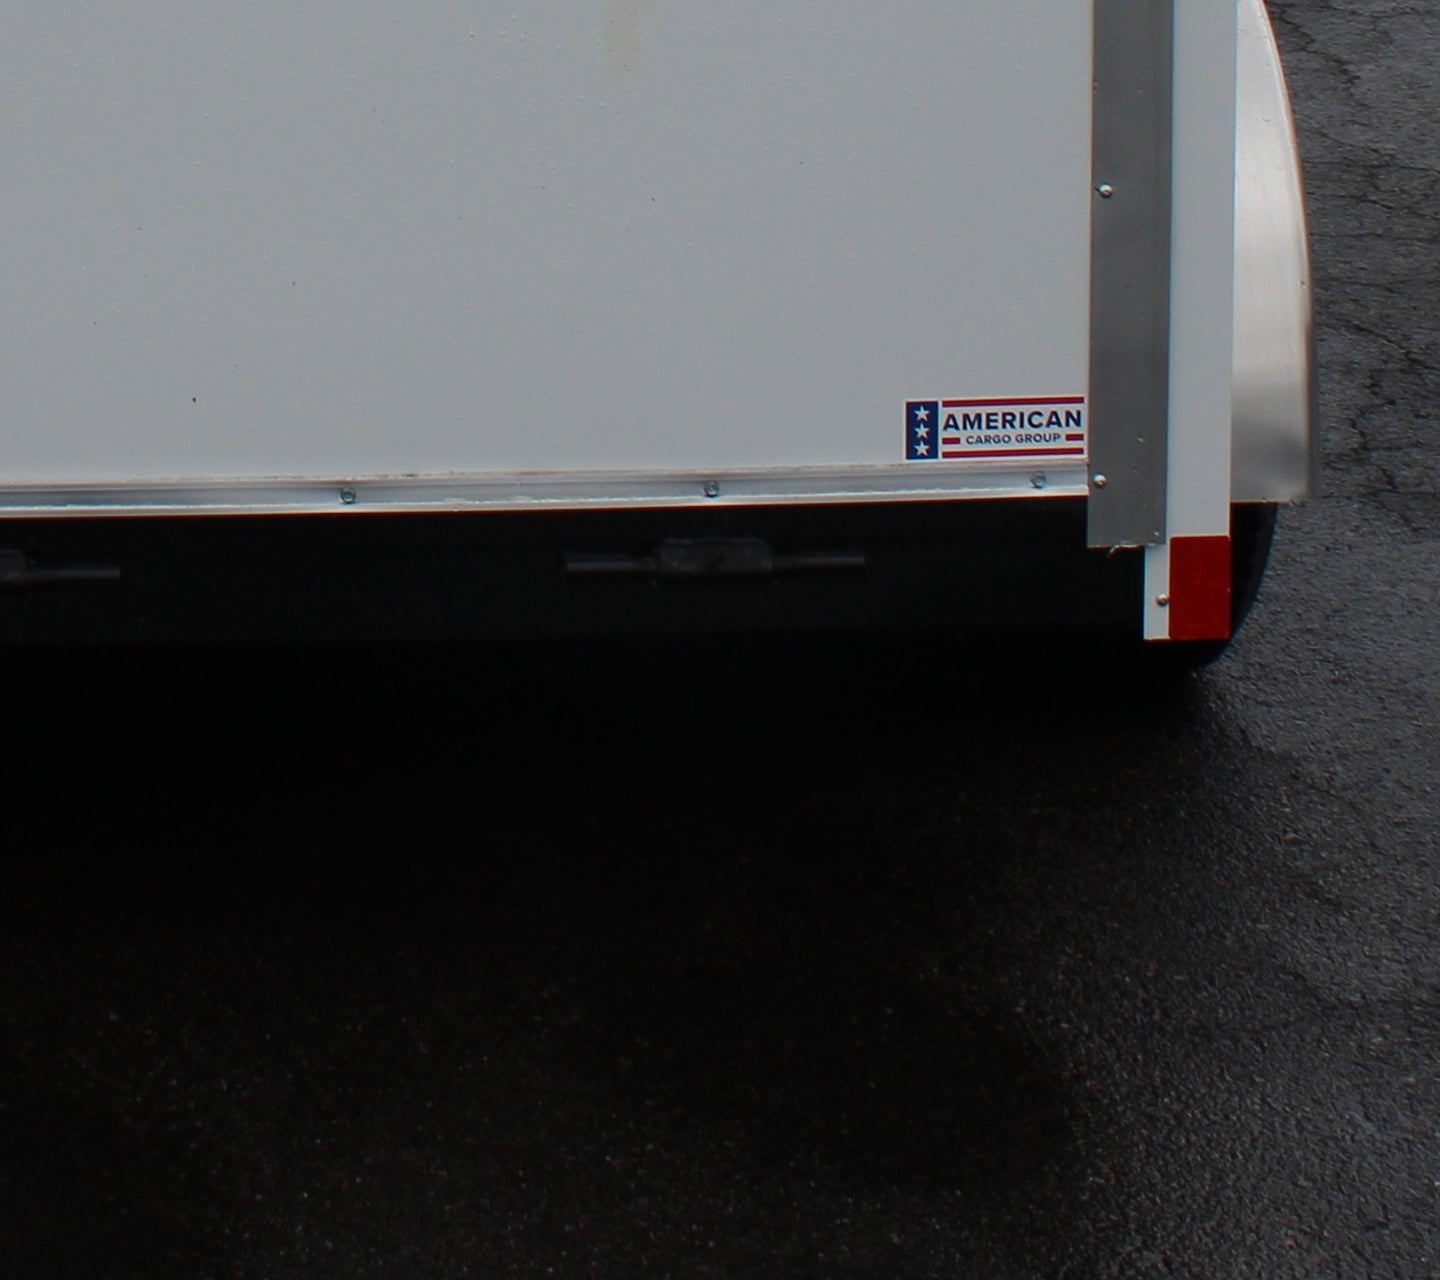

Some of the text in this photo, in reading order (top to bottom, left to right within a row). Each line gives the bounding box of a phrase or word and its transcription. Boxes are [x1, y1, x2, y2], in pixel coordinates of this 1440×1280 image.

[943, 409, 1082, 431] AMERICAN
[965, 433, 1062, 446] CARGO GROUP
